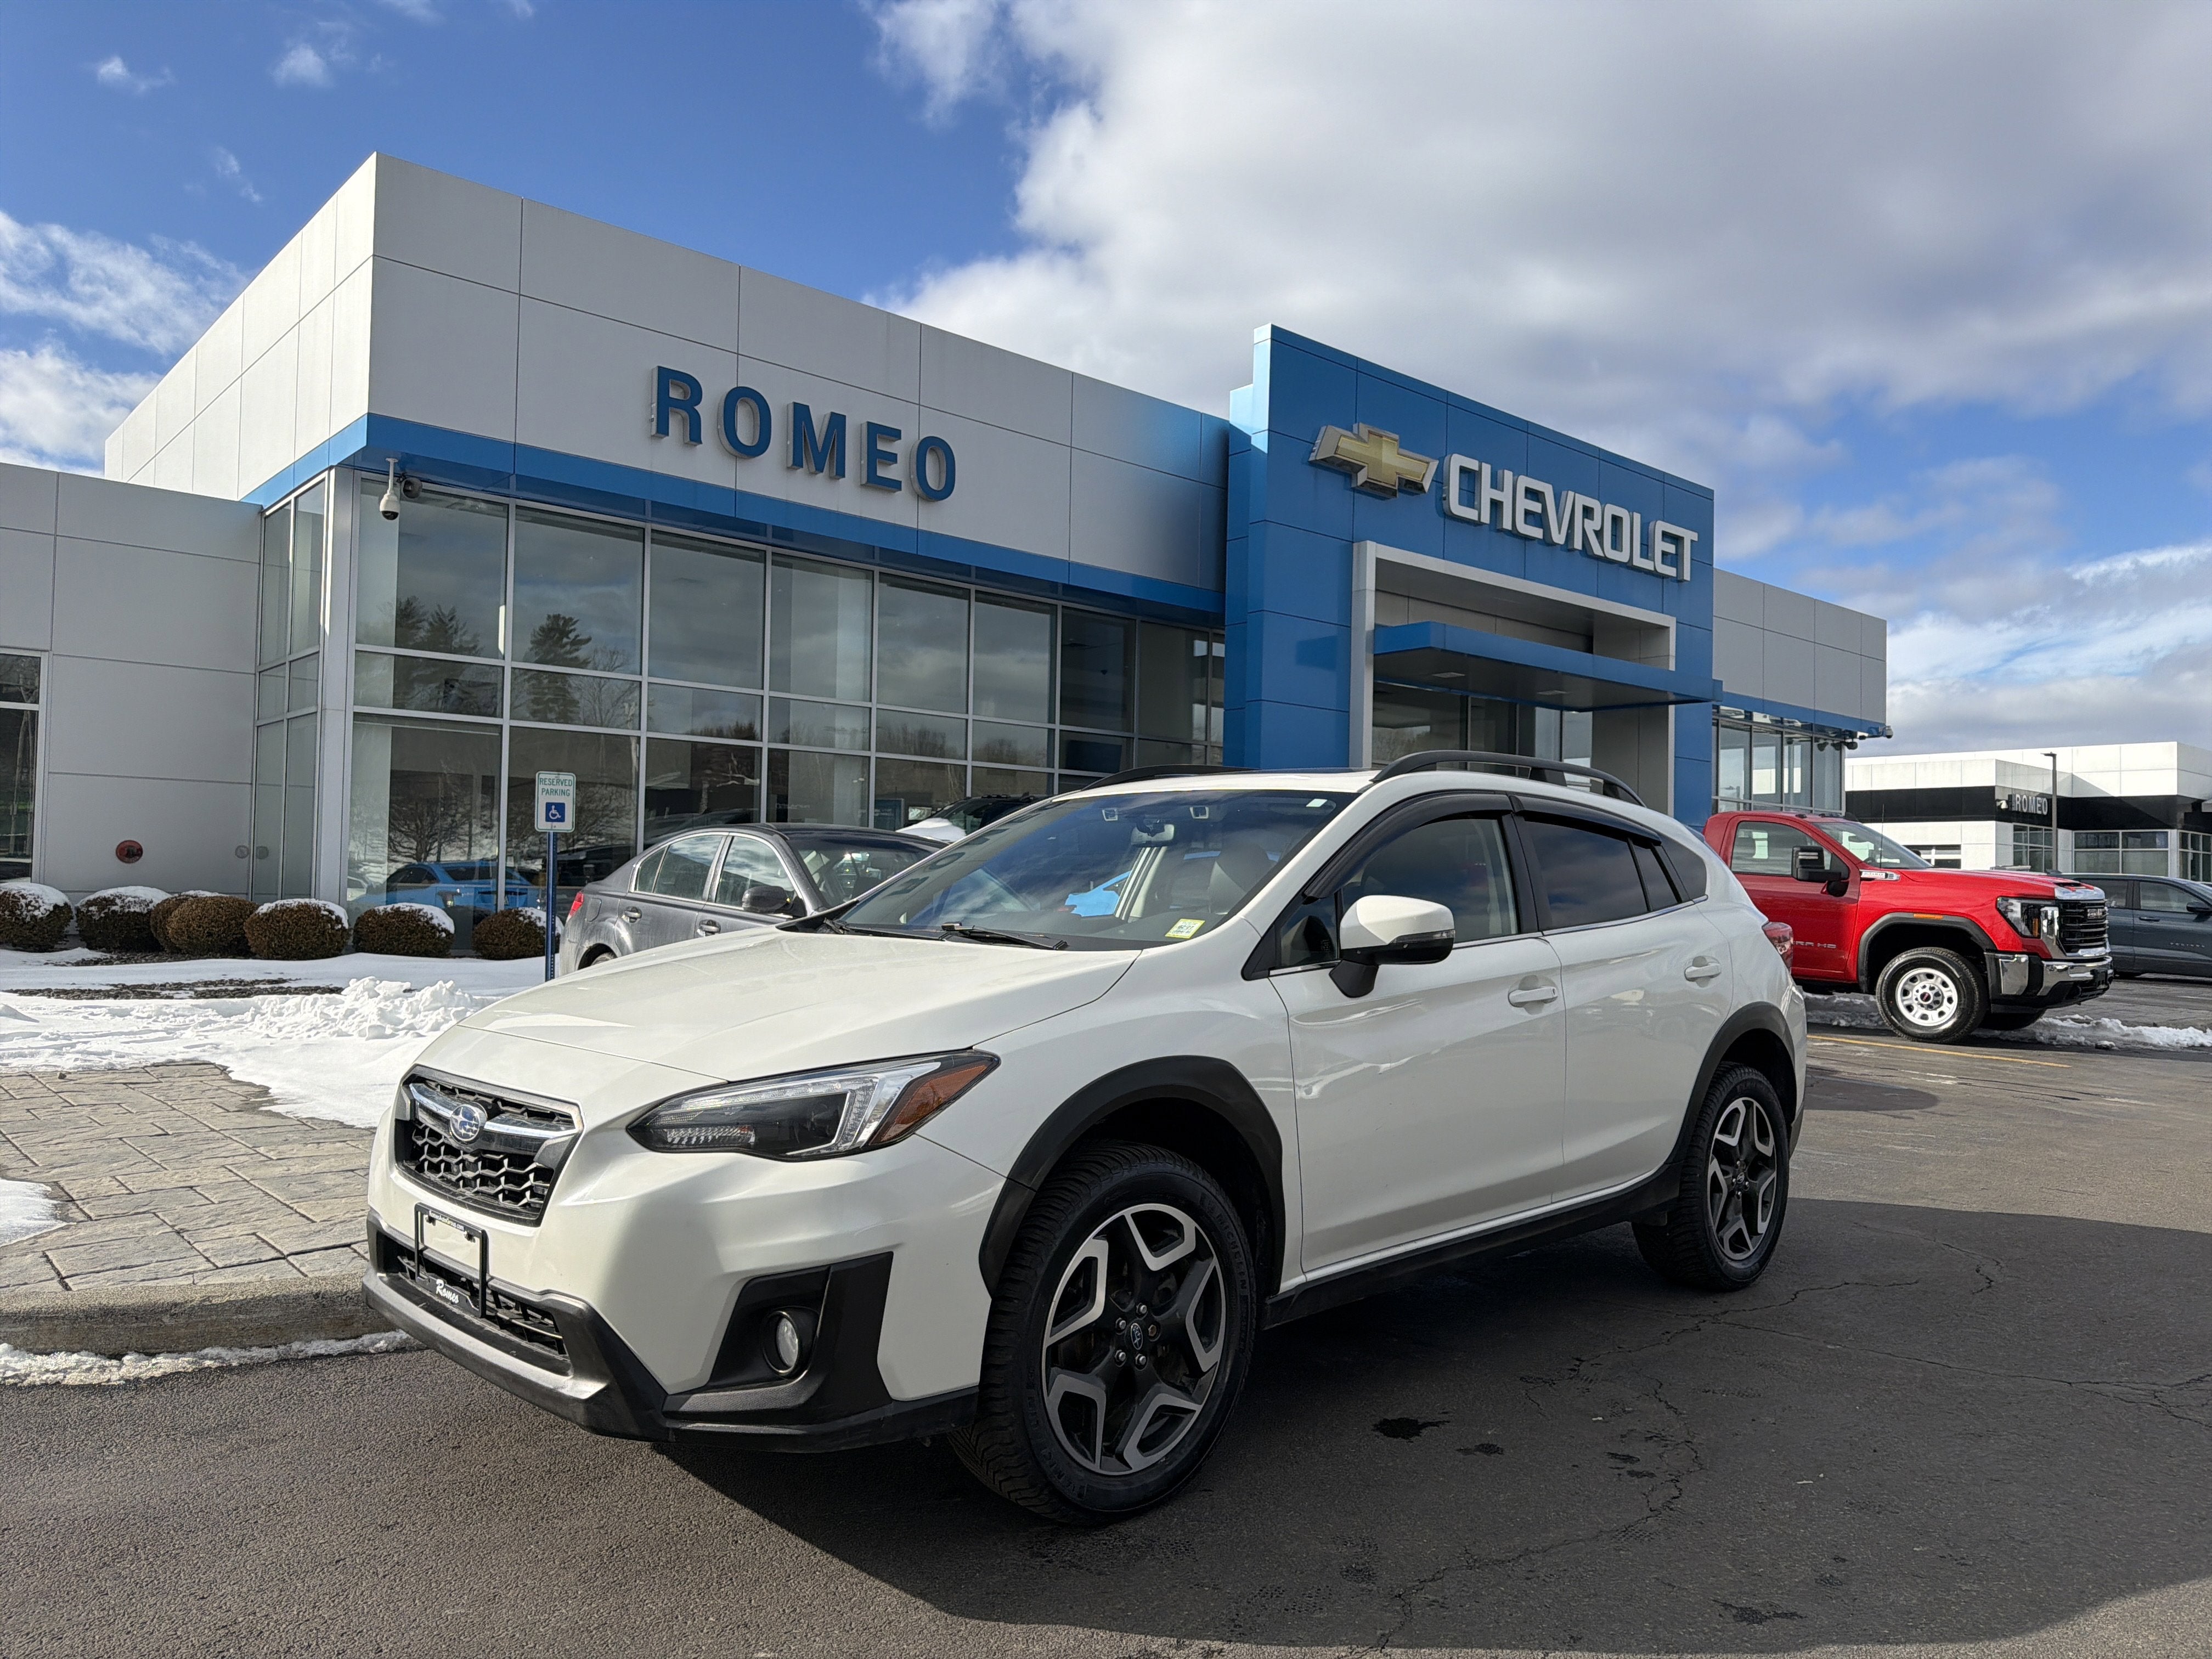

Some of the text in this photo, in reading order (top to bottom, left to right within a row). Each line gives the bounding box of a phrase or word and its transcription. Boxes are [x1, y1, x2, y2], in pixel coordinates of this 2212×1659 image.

[651, 365, 956, 503] ROMEO
[1443, 453, 1699, 582] CHEVROLET
[539, 777, 573, 787] RESERVED
[541, 787, 571, 797] PARKING
[2013, 794, 2048, 815] ROMEO
[436, 1279, 459, 1304] Romeo
